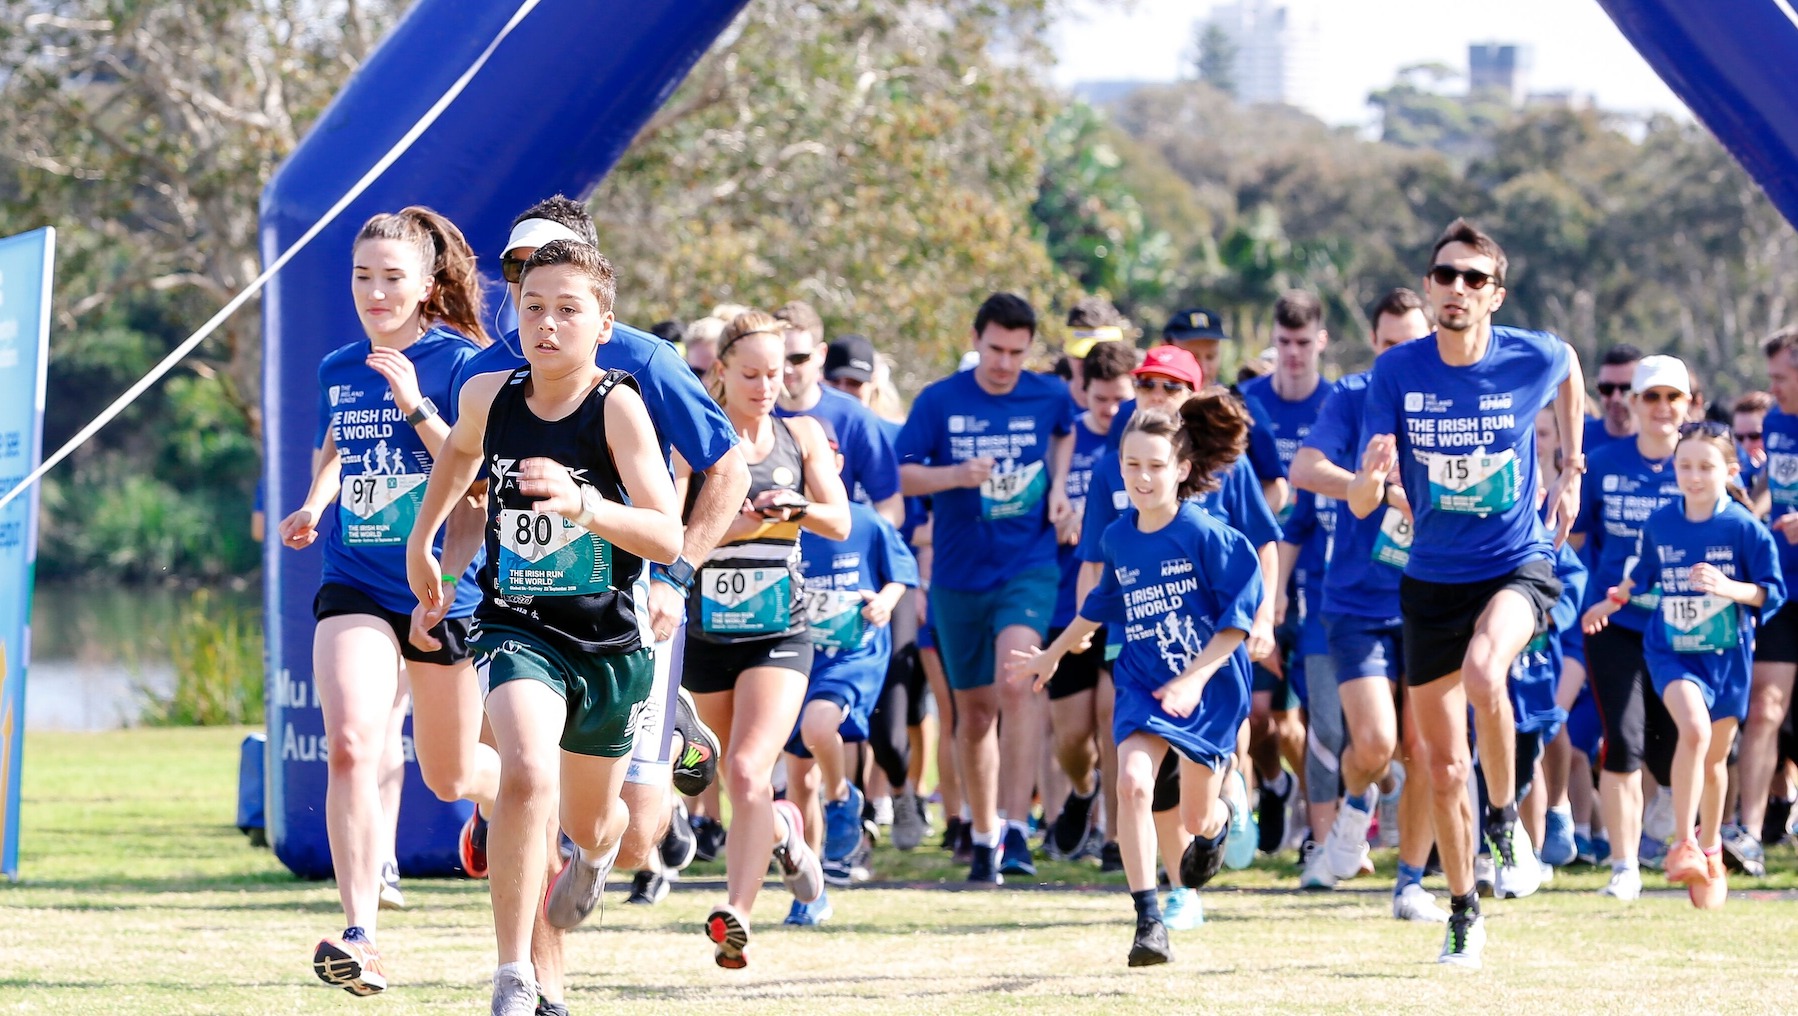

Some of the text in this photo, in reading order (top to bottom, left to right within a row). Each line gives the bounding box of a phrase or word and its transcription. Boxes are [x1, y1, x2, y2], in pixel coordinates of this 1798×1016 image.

[343, 410, 380, 424] IRISH
[1406, 414, 1515, 432] THE IRISH RUN
[342, 424, 393, 440] WORLD
[1407, 430, 1495, 447] THE WORLD
[1446, 459, 1469, 479] 15
[353, 478, 377, 504] 97
[515, 513, 552, 545] 80
[509, 569, 563, 578] THE IRISH RUN
[1161, 562, 1193, 577] KPMG
[509, 577, 553, 586] THE WORLD
[717, 572, 745, 594] 60
[1130, 584, 1165, 606] IRISH
[1165, 577, 1198, 597] RUN
[1132, 595, 1183, 620] WORLD
[1672, 600, 1698, 620] 115
